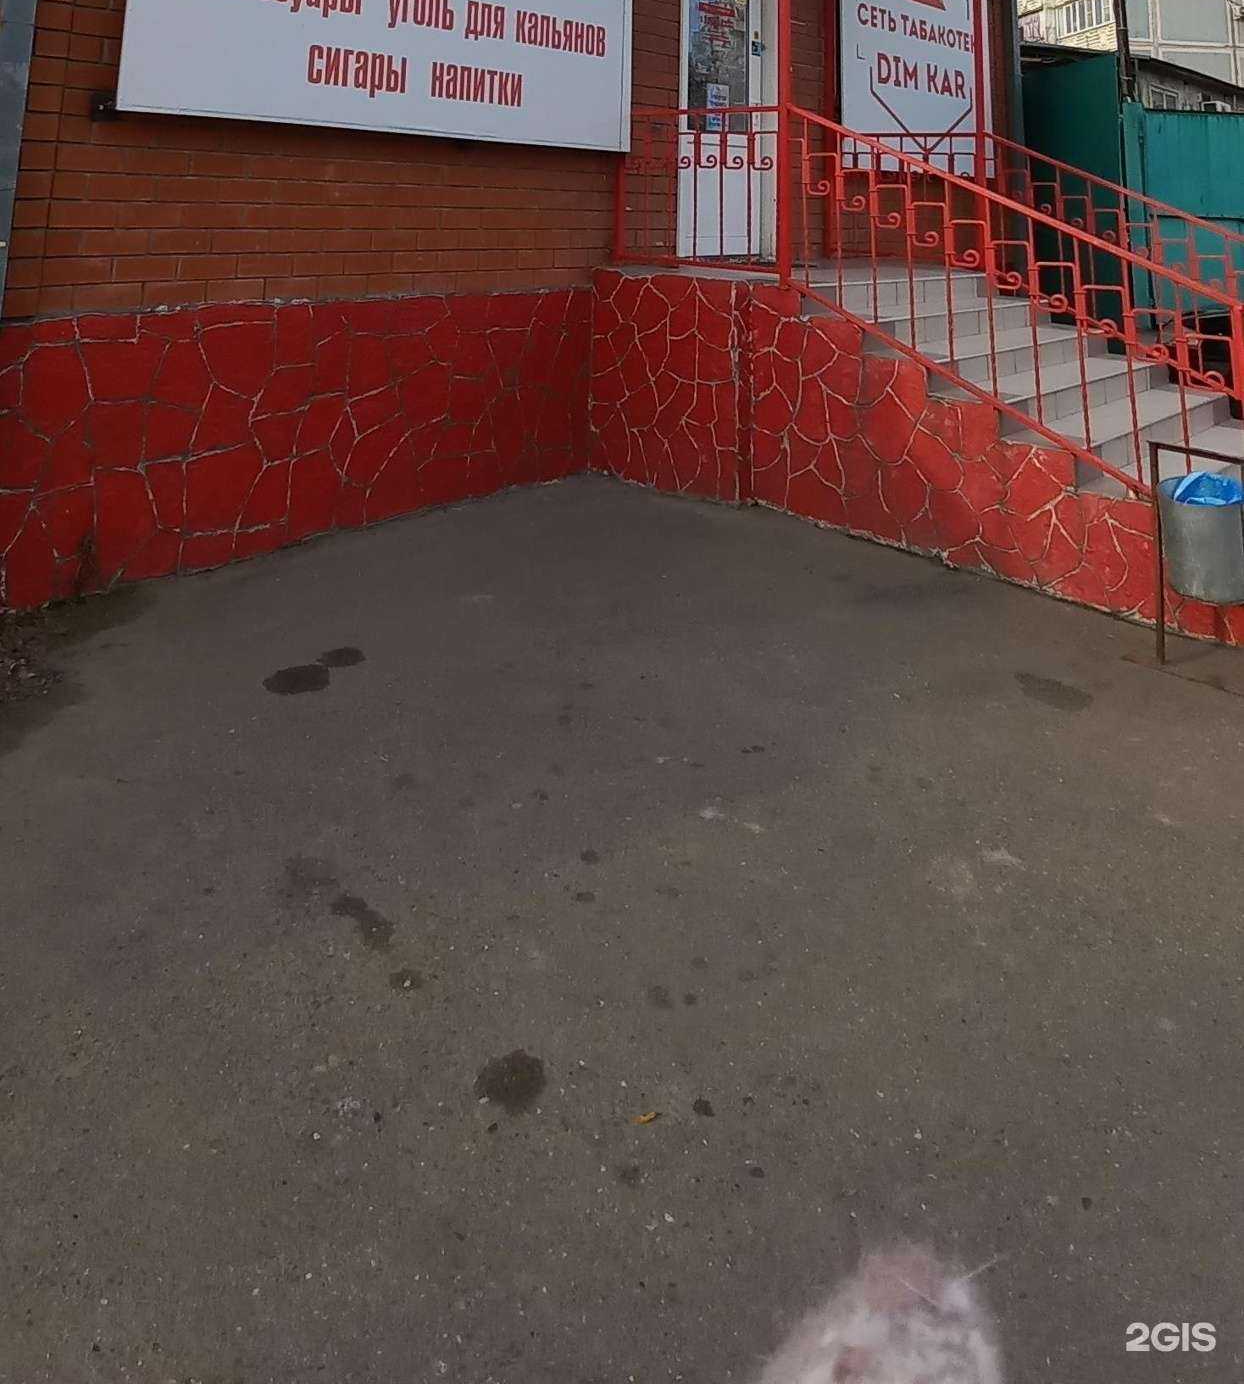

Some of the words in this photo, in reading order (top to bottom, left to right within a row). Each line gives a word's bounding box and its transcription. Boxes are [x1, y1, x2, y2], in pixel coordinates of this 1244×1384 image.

[465, 0, 505, 41] для
[516, 9, 606, 57] кальянов
[857, 3, 896, 33] СЕТЬ
[308, 45, 407, 98] сигары
[431, 62, 523, 107] напитки
[877, 52, 918, 91] DIM
[926, 63, 966, 100] KAR
